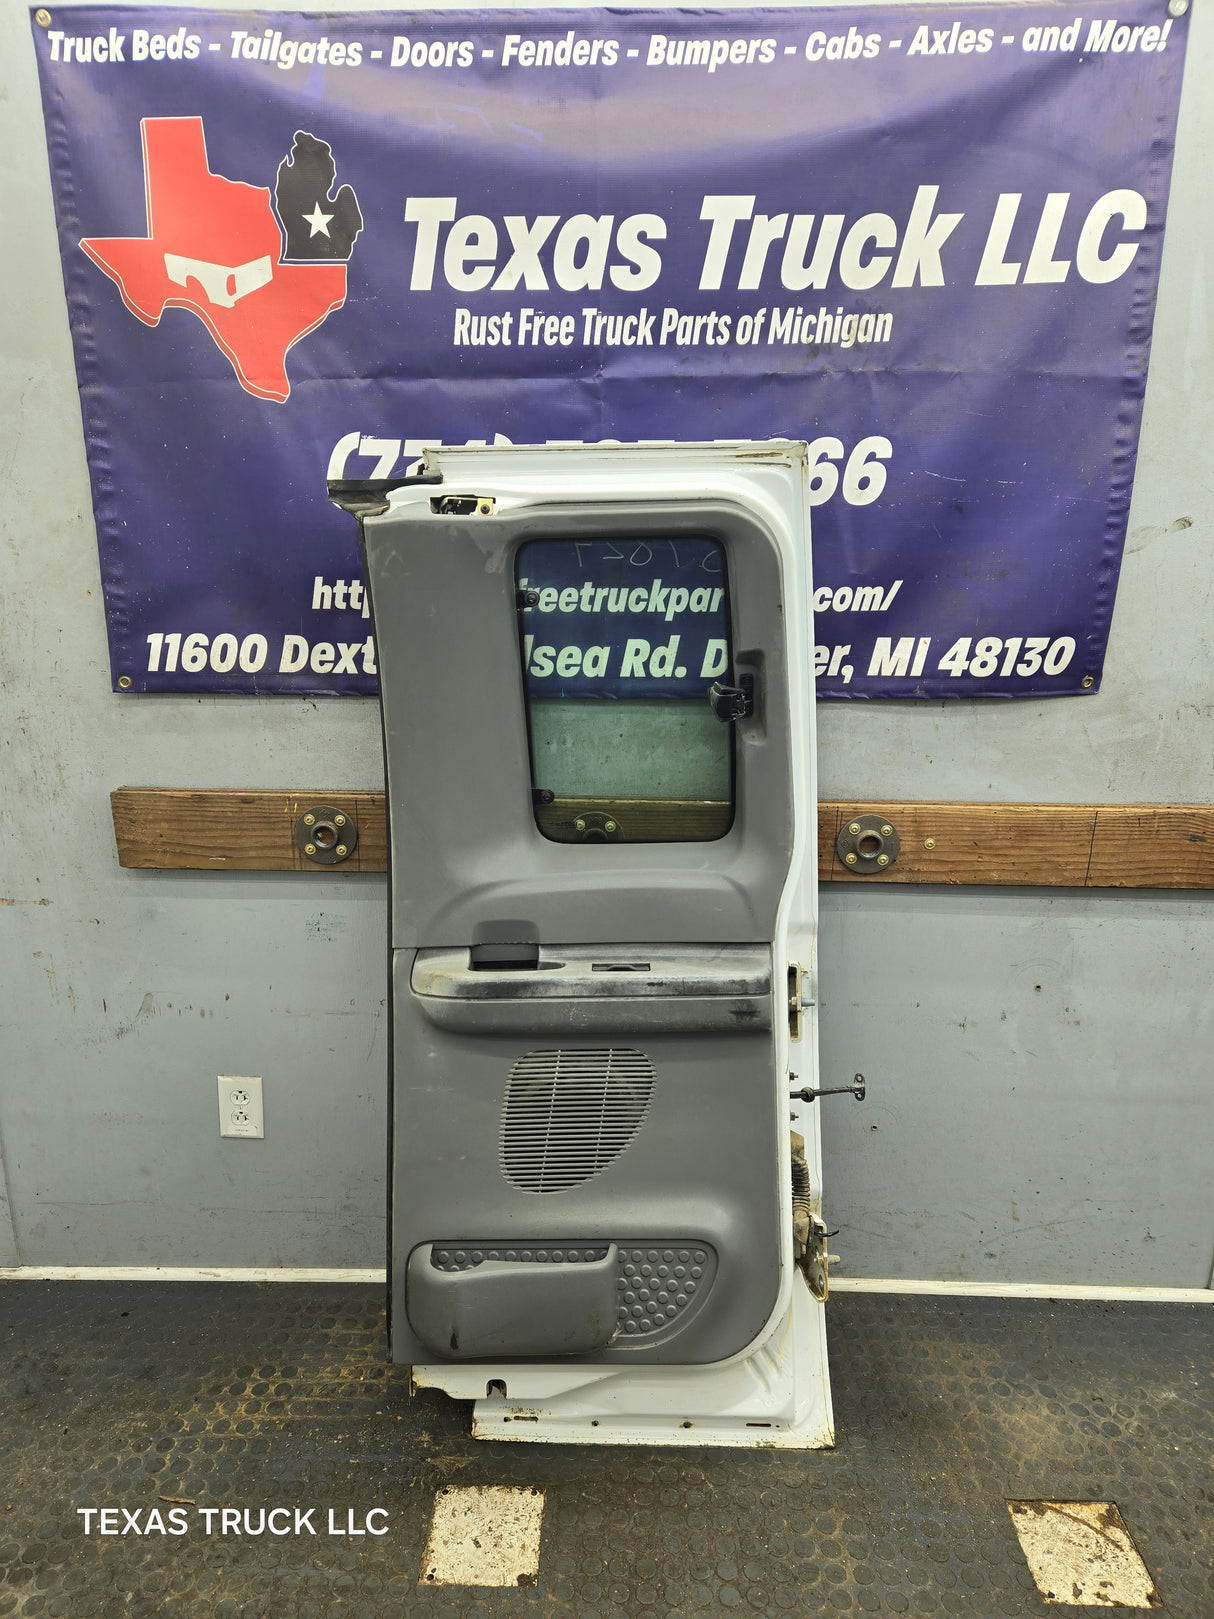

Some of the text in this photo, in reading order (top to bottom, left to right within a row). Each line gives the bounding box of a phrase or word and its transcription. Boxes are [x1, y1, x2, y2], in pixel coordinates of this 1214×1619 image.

[48, 29, 124, 63] Truck
[133, 27, 201, 61] Beds
[230, 31, 363, 70] Tailgates
[390, 36, 474, 67] Doors
[502, 31, 619, 66] Fenders
[646, 35, 777, 73] Bumpers
[806, 31, 881, 61] Cabs
[907, 25, 994, 55] Axles
[1022, 18, 1081, 53] and
[1084, 19, 1173, 53] More!
[404, 185, 1147, 292] Texas Truck LLC
[454, 307, 893, 348] Rust Free Truck Parts of Michigan
[146, 633, 268, 673] 11600
[620, 635, 687, 678] Rd.
[867, 637, 932, 676] MI
[937, 636, 1076, 677] 48130
